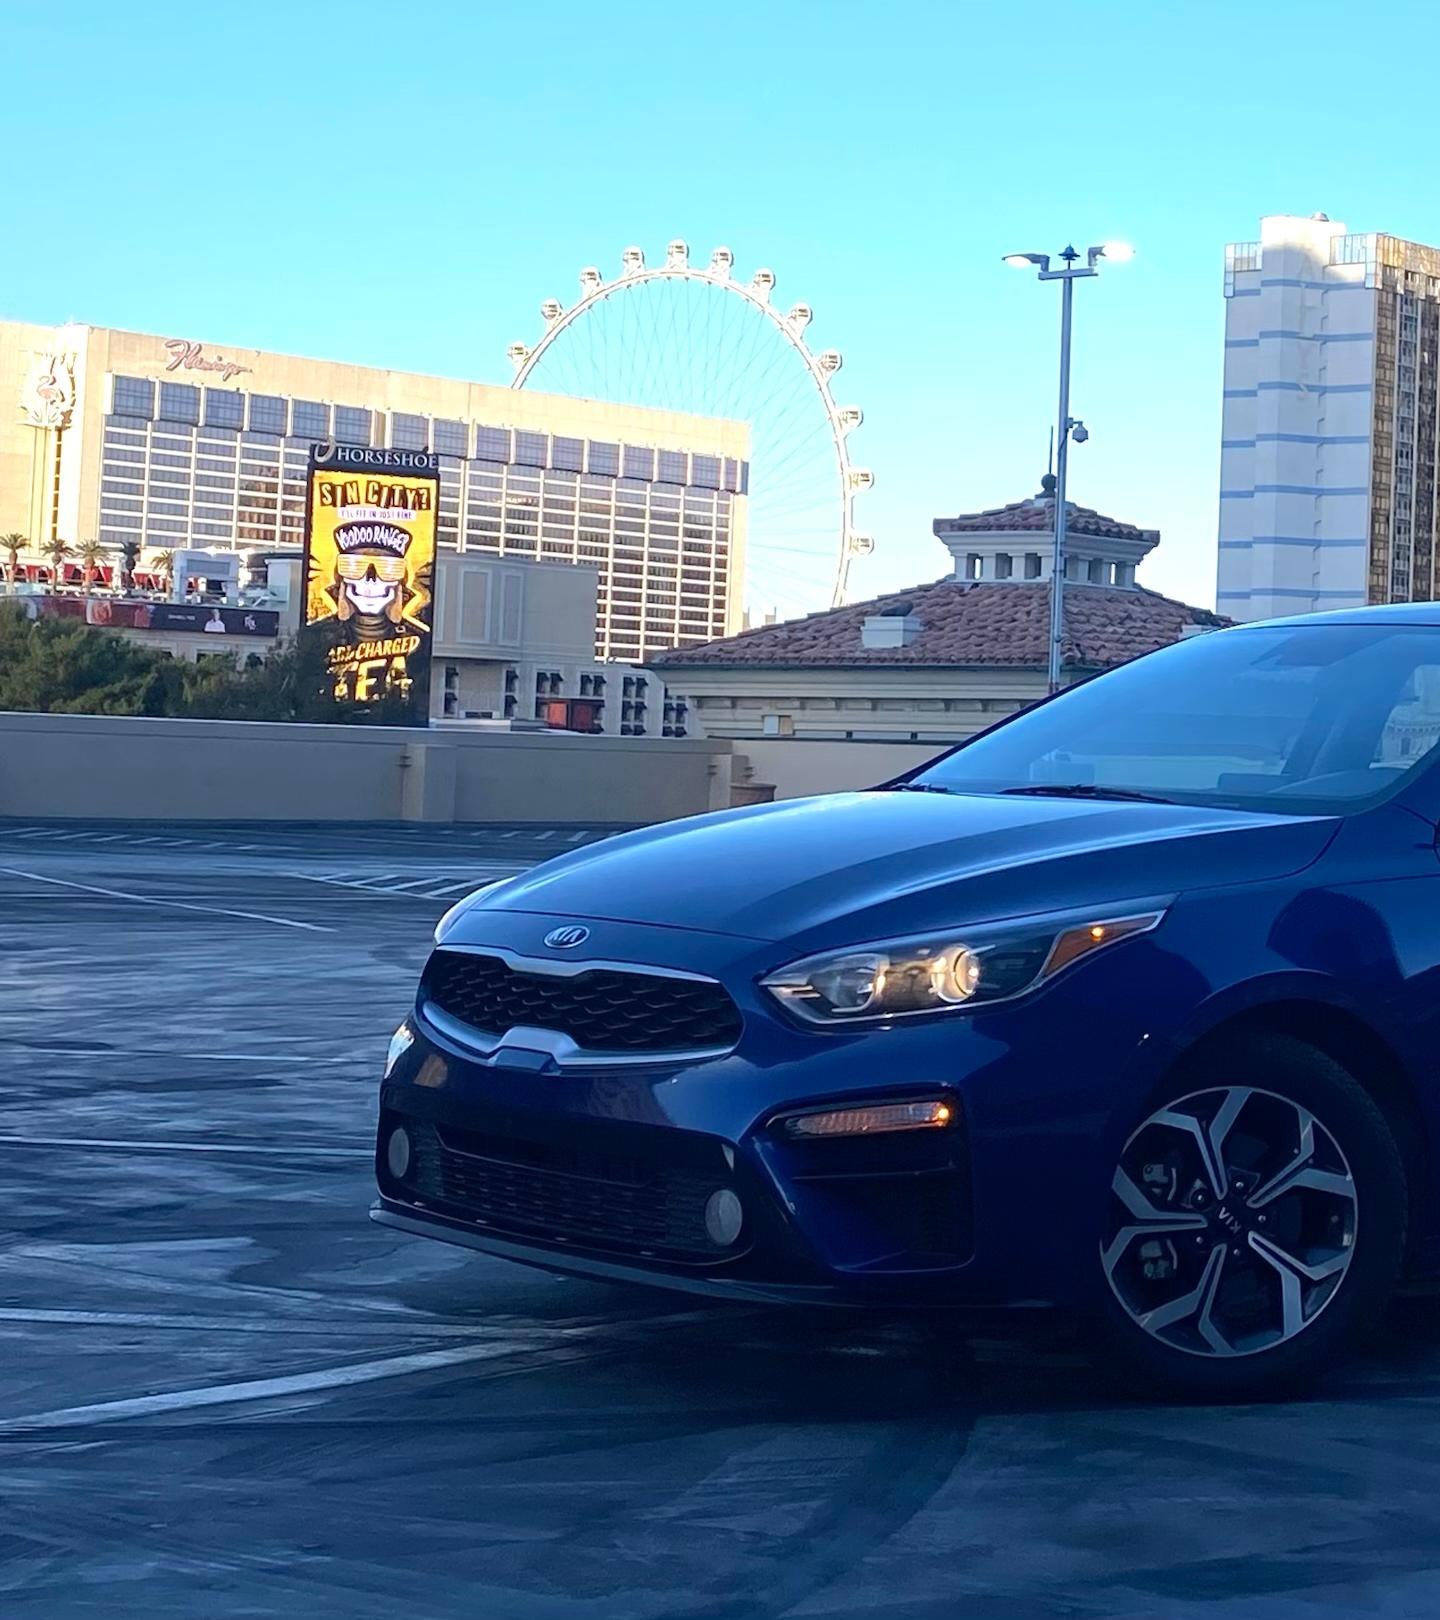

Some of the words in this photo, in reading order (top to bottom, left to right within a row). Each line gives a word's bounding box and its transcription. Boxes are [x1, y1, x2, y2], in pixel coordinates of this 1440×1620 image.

[337, 448, 438, 469] HORSESHOE
[320, 482, 358, 508] SIN
[367, 482, 428, 510] CITY?
[335, 525, 373, 550] VOODOO
[373, 525, 410, 556] RANGER
[355, 635, 421, 661] CHARGED
